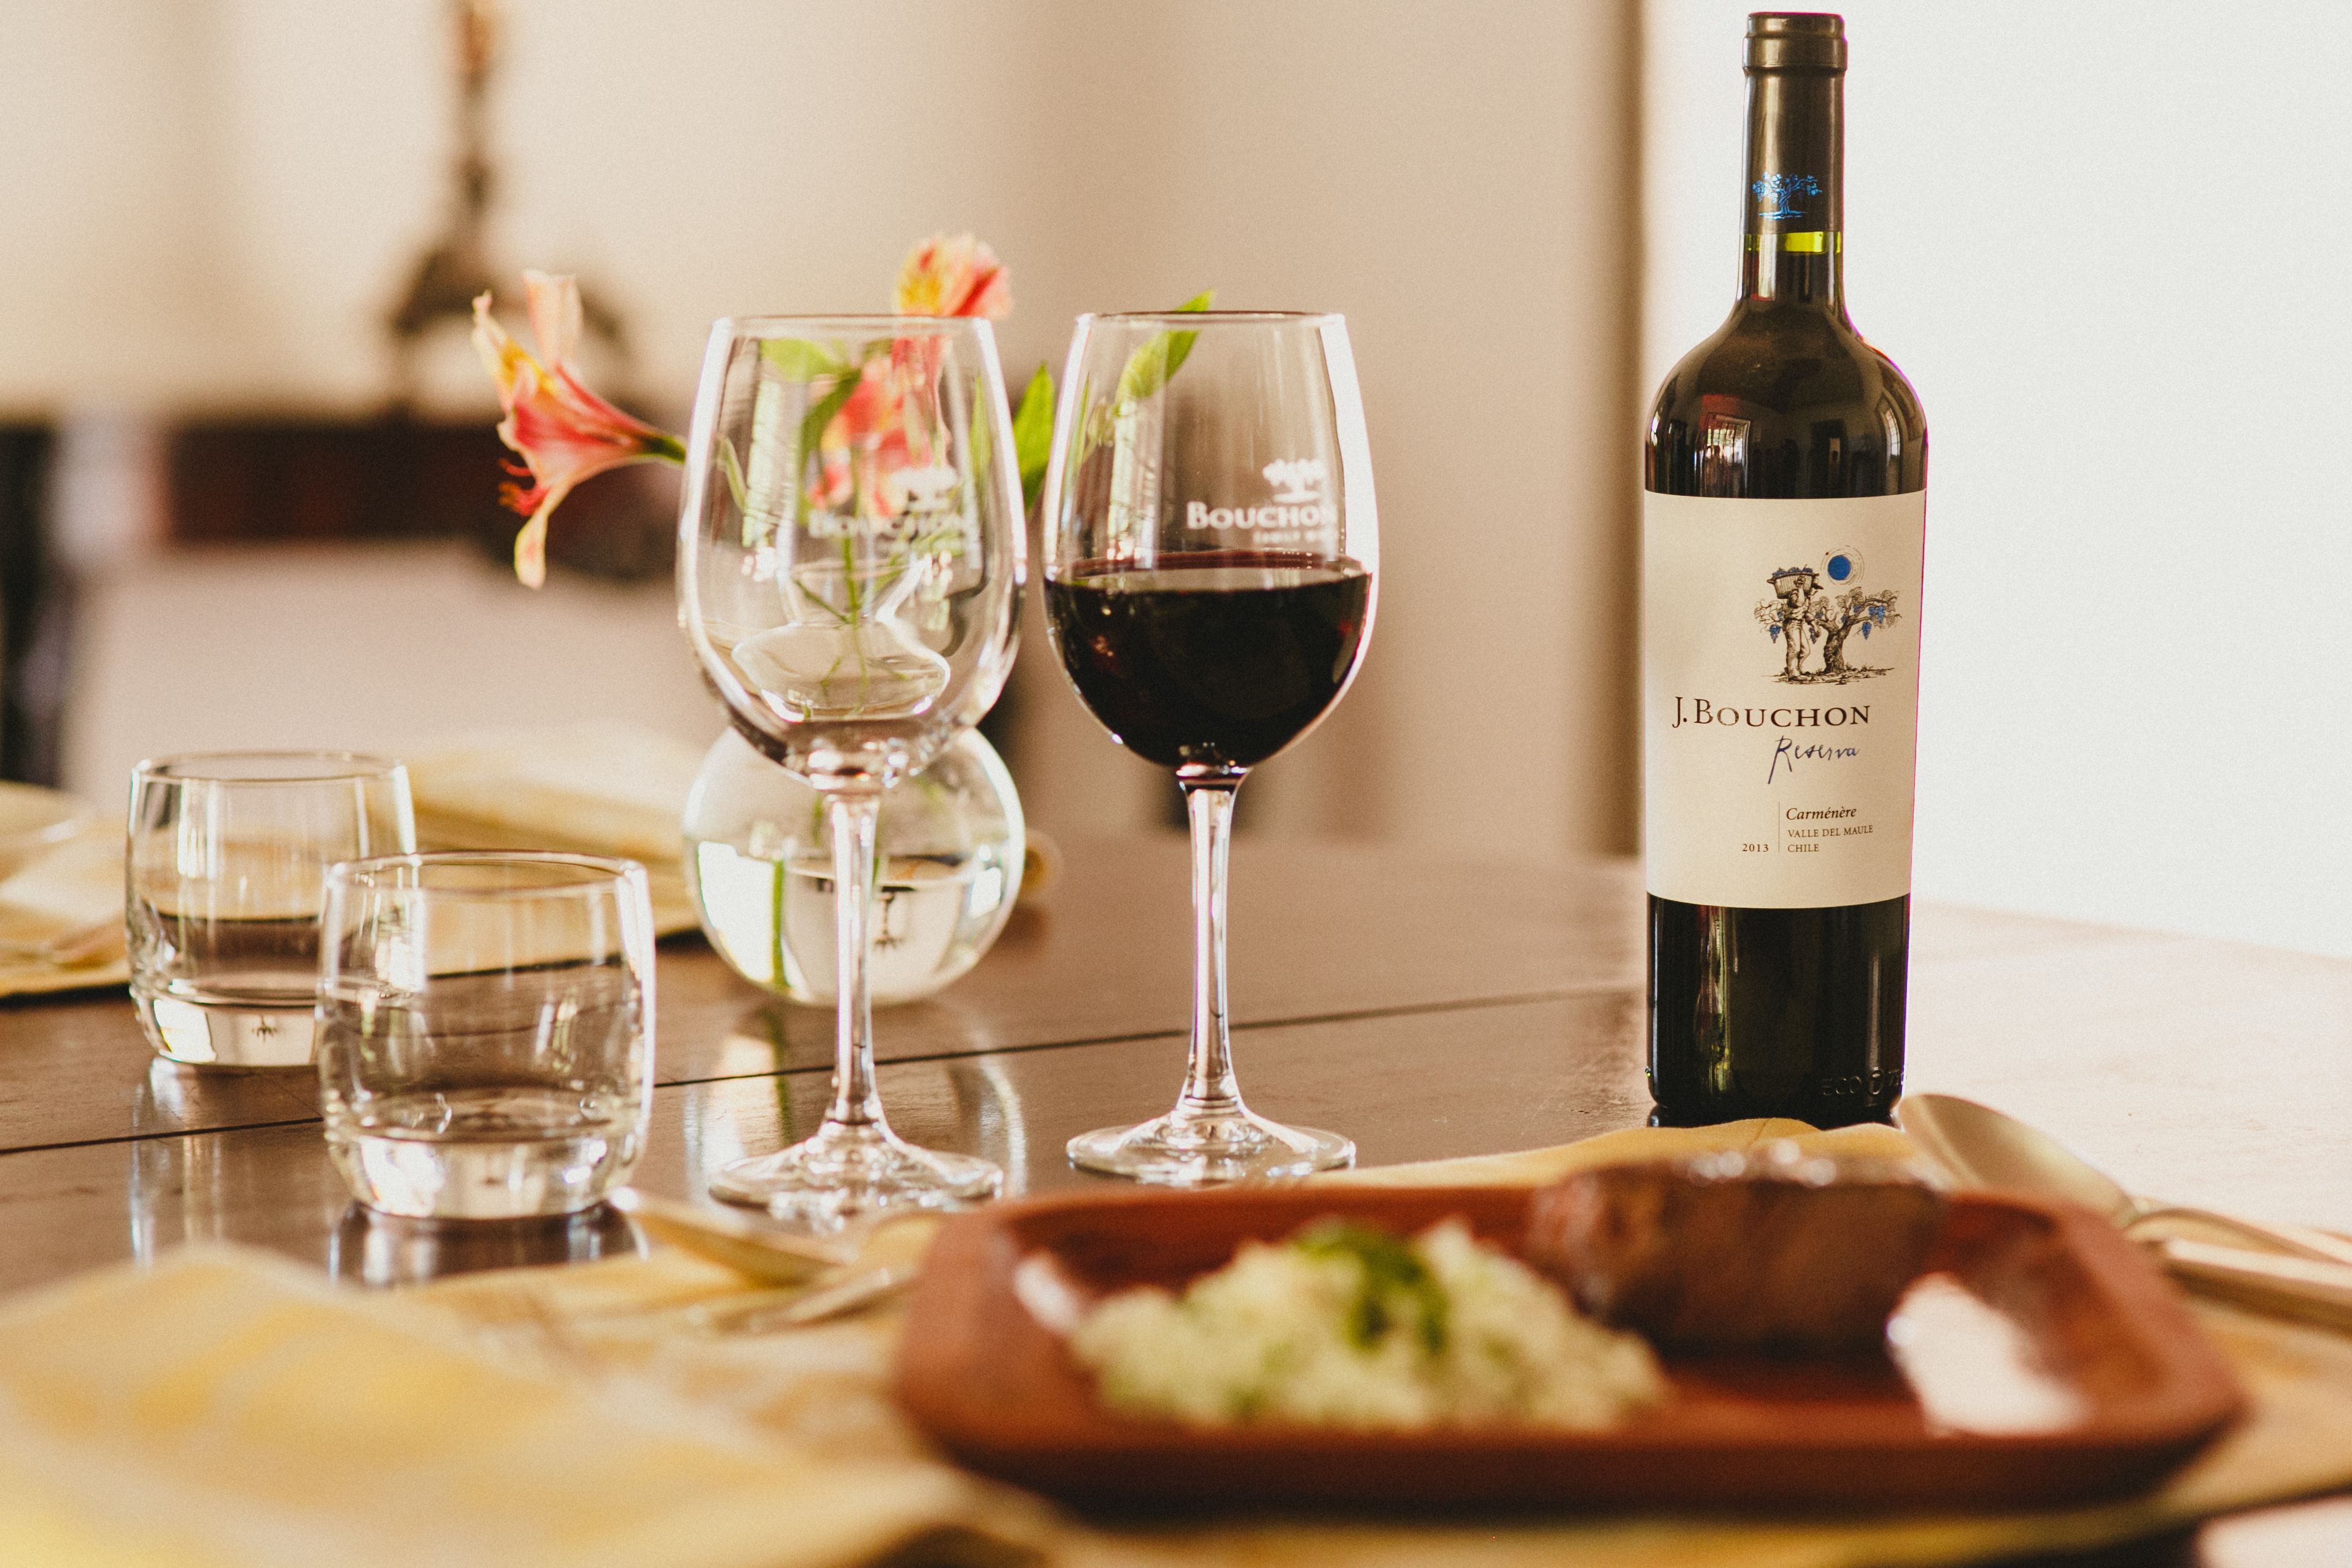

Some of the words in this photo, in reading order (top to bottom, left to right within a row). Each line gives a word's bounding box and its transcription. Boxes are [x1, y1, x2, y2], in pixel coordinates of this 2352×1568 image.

[1767, 735, 1860, 785] Reserva
[1785, 806, 1857, 821] Carménère
[1787, 829, 1819, 838] VALLE
[1822, 827, 1841, 837] DEL
[1843, 824, 1873, 836] MAULE
[1742, 843, 1770, 852] 2013
[1787, 843, 1819, 853] CHILE
